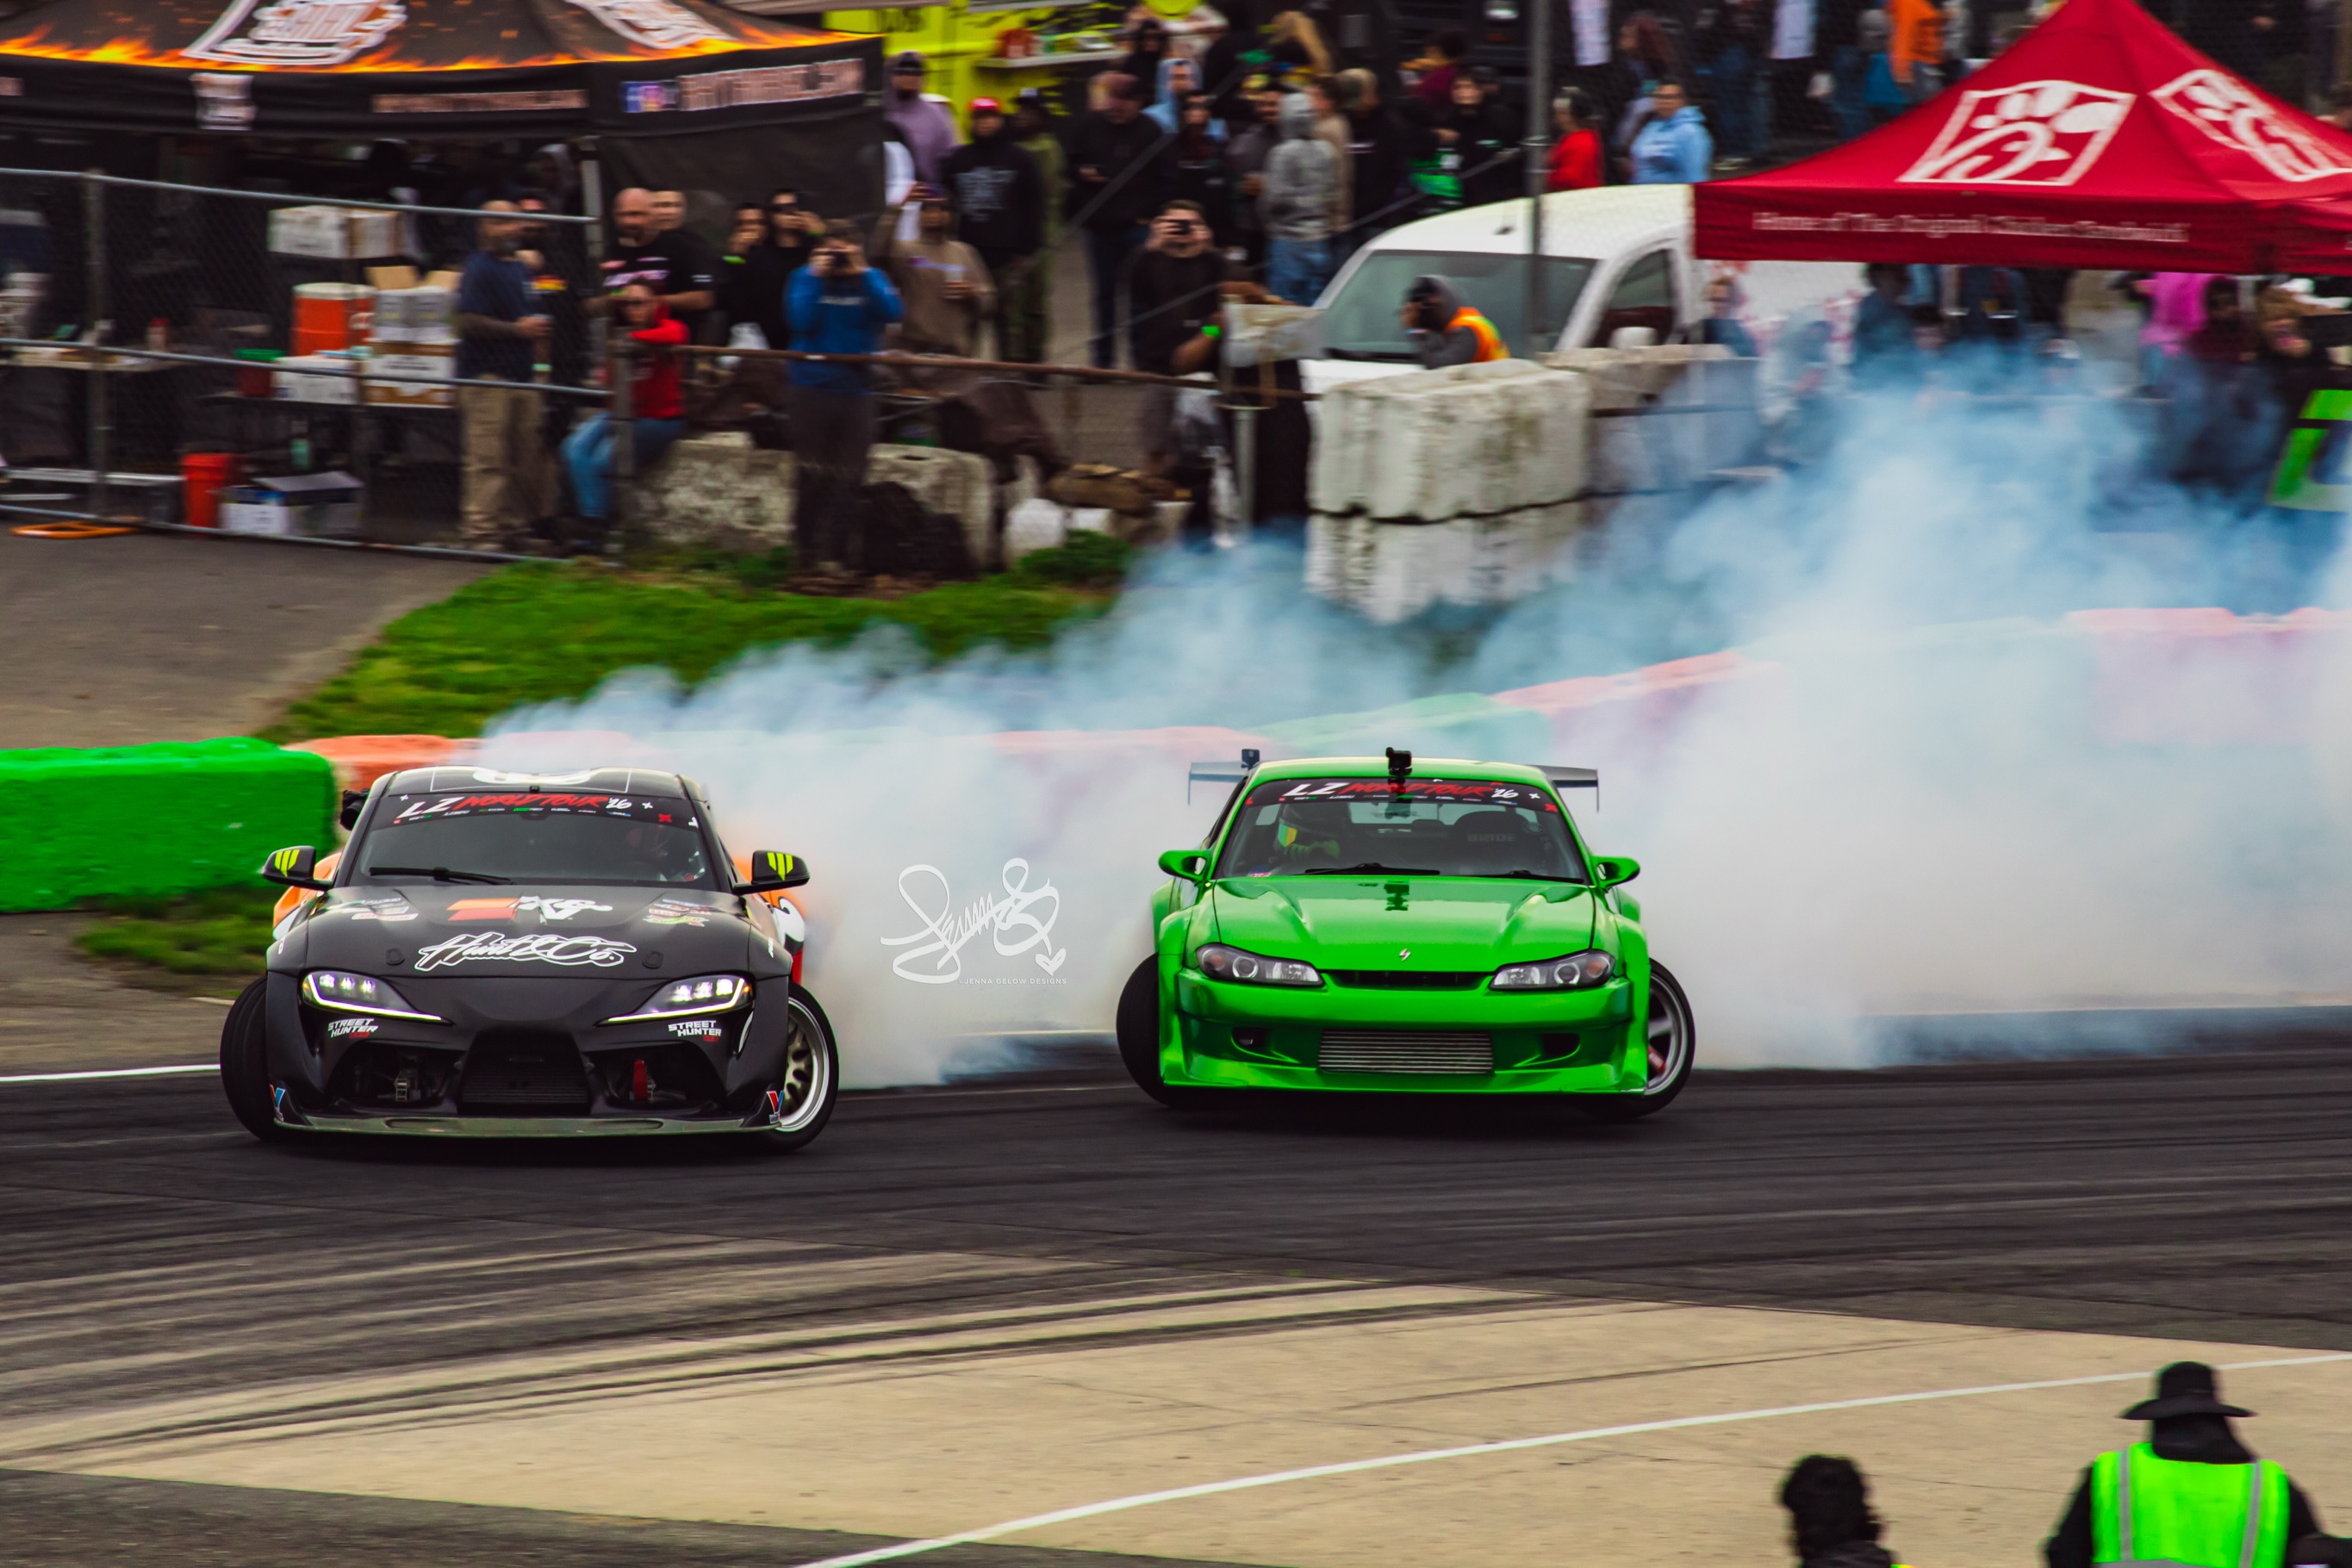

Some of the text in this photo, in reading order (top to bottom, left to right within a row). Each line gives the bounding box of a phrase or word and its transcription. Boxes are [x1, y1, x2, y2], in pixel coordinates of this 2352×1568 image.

[1282, 782, 1350, 797] LZ
[396, 796, 465, 818] LZ
[1467, 833, 1516, 842] BRIDE
[327, 1018, 374, 1031] STREET
[668, 1020, 717, 1031] STREET
[331, 1025, 379, 1038] HUNTER
[677, 1028, 722, 1037] HUNTER
